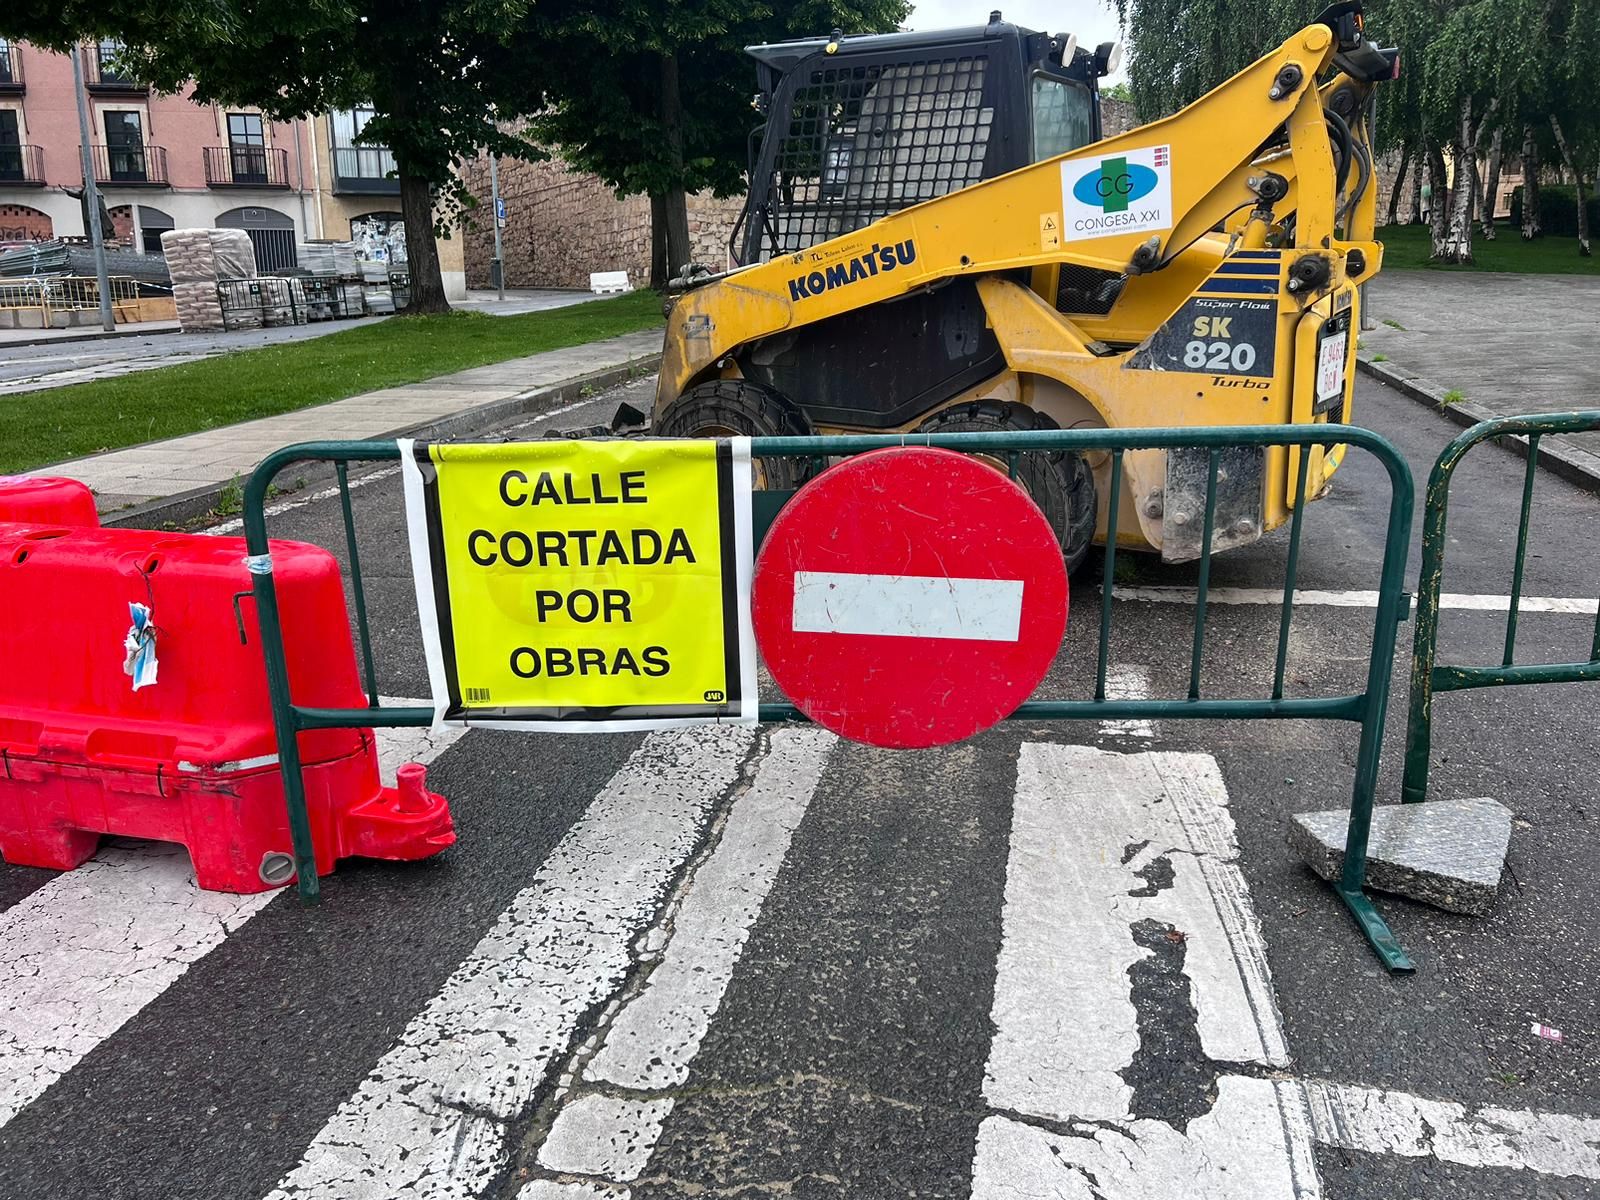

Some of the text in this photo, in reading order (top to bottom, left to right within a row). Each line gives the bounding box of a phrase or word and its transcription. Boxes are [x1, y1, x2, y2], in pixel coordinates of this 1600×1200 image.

[1096, 173, 1134, 198] CG
[497, 200, 503, 217] P
[1074, 209, 1160, 231] CONGESA XXI
[788, 239, 916, 302] KOMATSU
[1195, 299, 1271, 310] Super Flow
[1192, 316, 1233, 338] SK
[1183, 340, 1256, 371] 820
[1211, 376, 1271, 390] Turbo
[499, 470, 648, 507] CALLE
[467, 528, 697, 567] CORTADA
[535, 589, 633, 623] POR
[510, 646, 671, 679] OBRAS
